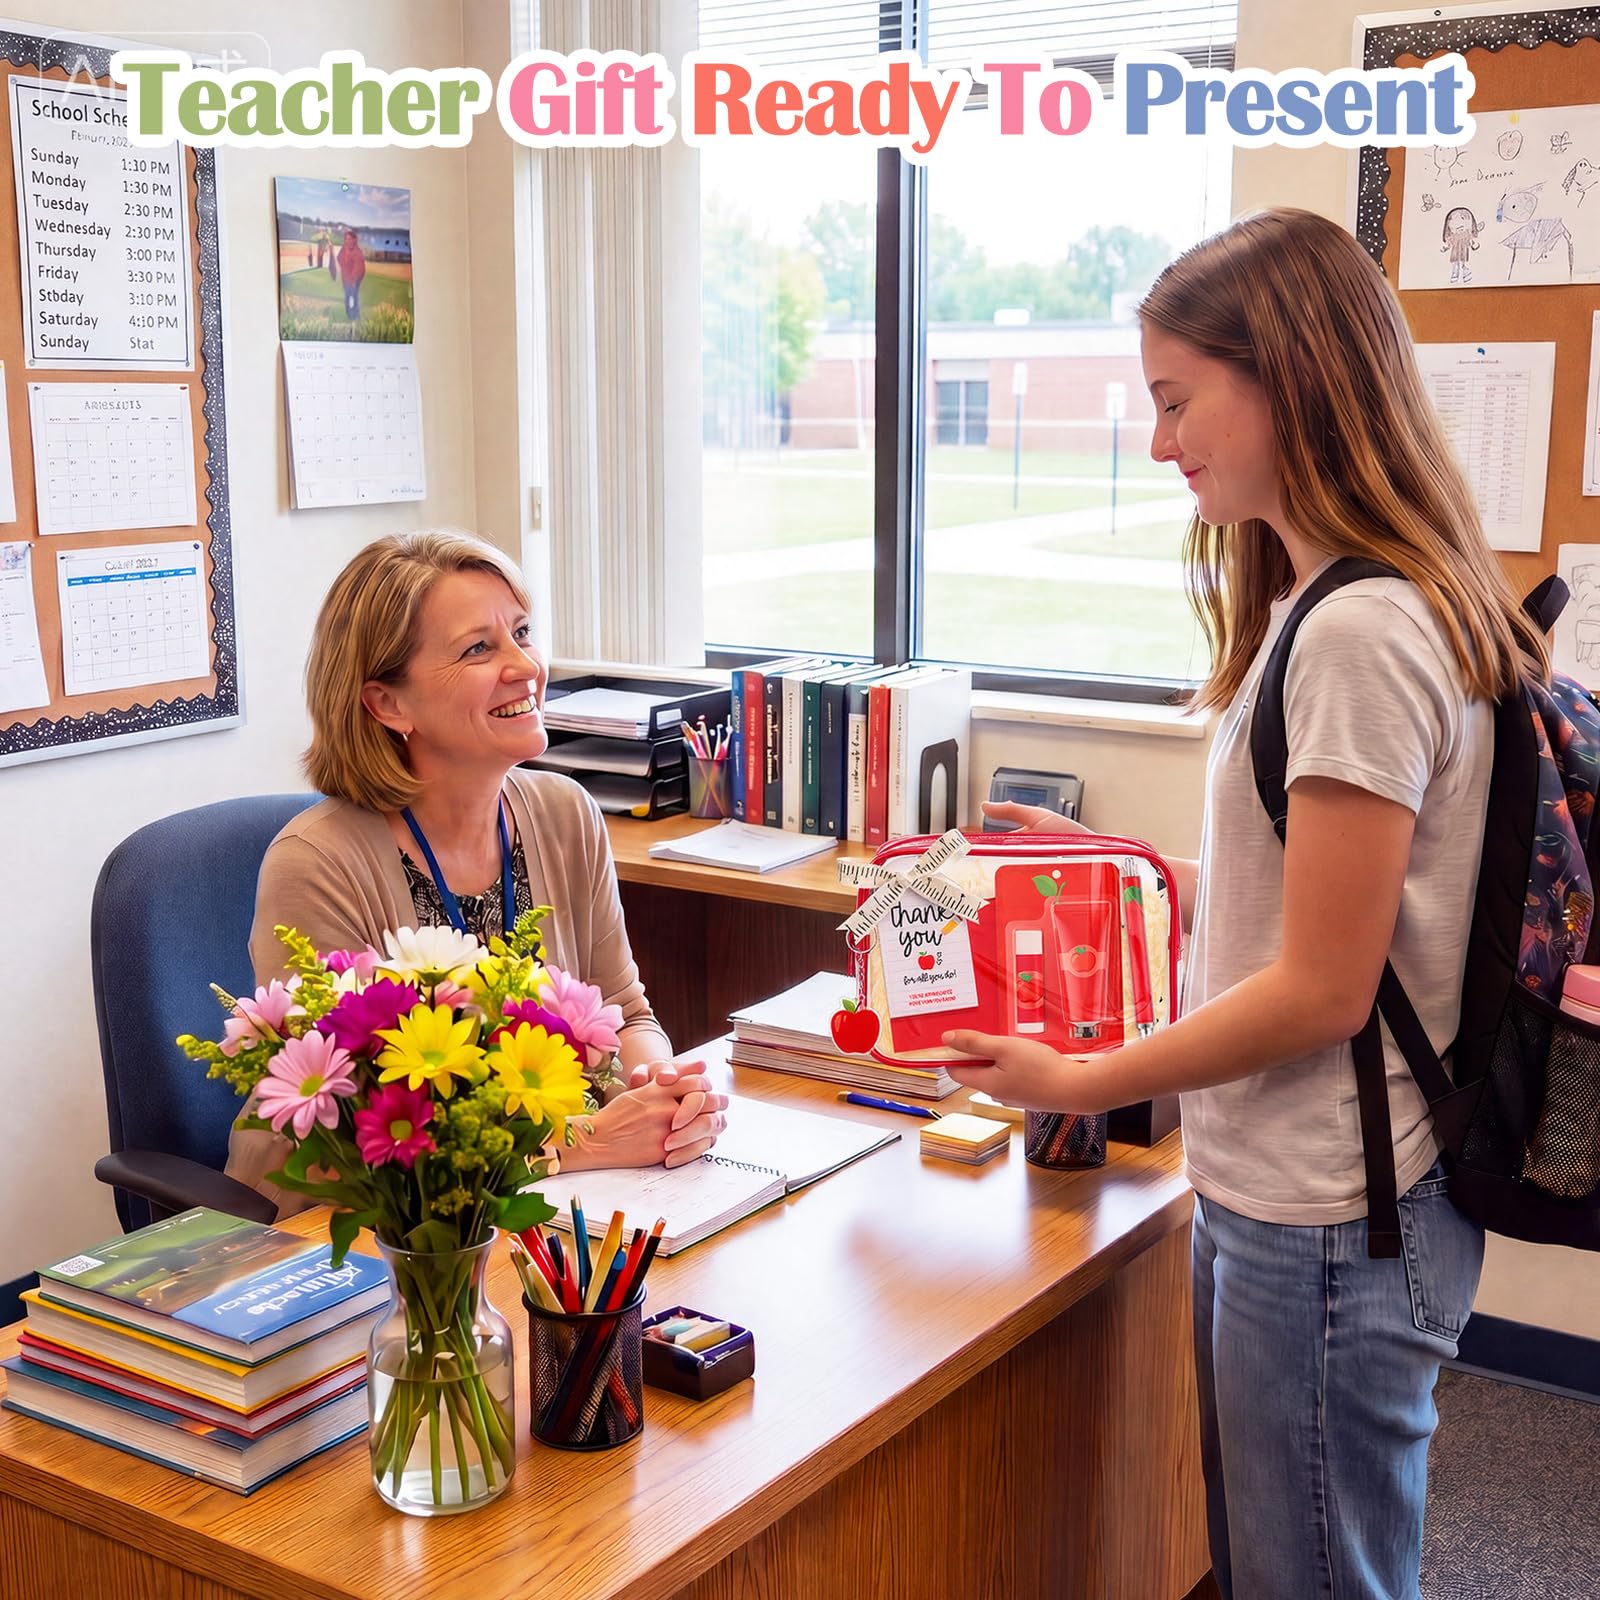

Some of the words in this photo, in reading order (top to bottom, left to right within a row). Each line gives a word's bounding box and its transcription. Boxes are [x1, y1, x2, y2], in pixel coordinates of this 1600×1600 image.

[32, 100, 88, 122] School
[94, 108, 128, 128] Sche
[31, 148, 79, 169] Sunday
[151, 161, 170, 174] PM
[32, 170, 86, 192] Monday
[124, 180, 148, 194] 1:30
[152, 183, 172, 196] PM
[33, 194, 88, 216] Tuesday
[124, 203, 150, 217] 2:30
[154, 206, 173, 219] PM
[35, 218, 112, 240] Wednesday
[125, 225, 151, 239] 2:30
[154, 228, 175, 240] PM
[36, 242, 96, 262] Thursday
[126, 248, 152, 262] 3:00
[156, 250, 176, 262] PM
[38, 265, 79, 284] Friday
[128, 270, 153, 283] 3:30
[156, 272, 176, 284] PM
[157, 294, 177, 306] PM
[40, 311, 98, 330] Saturday
[158, 316, 178, 328] PM
[40, 334, 90, 352] Sunday
[130, 336, 155, 350] Stat
[891, 902, 955, 928] thank
[899, 930, 942, 958] you
